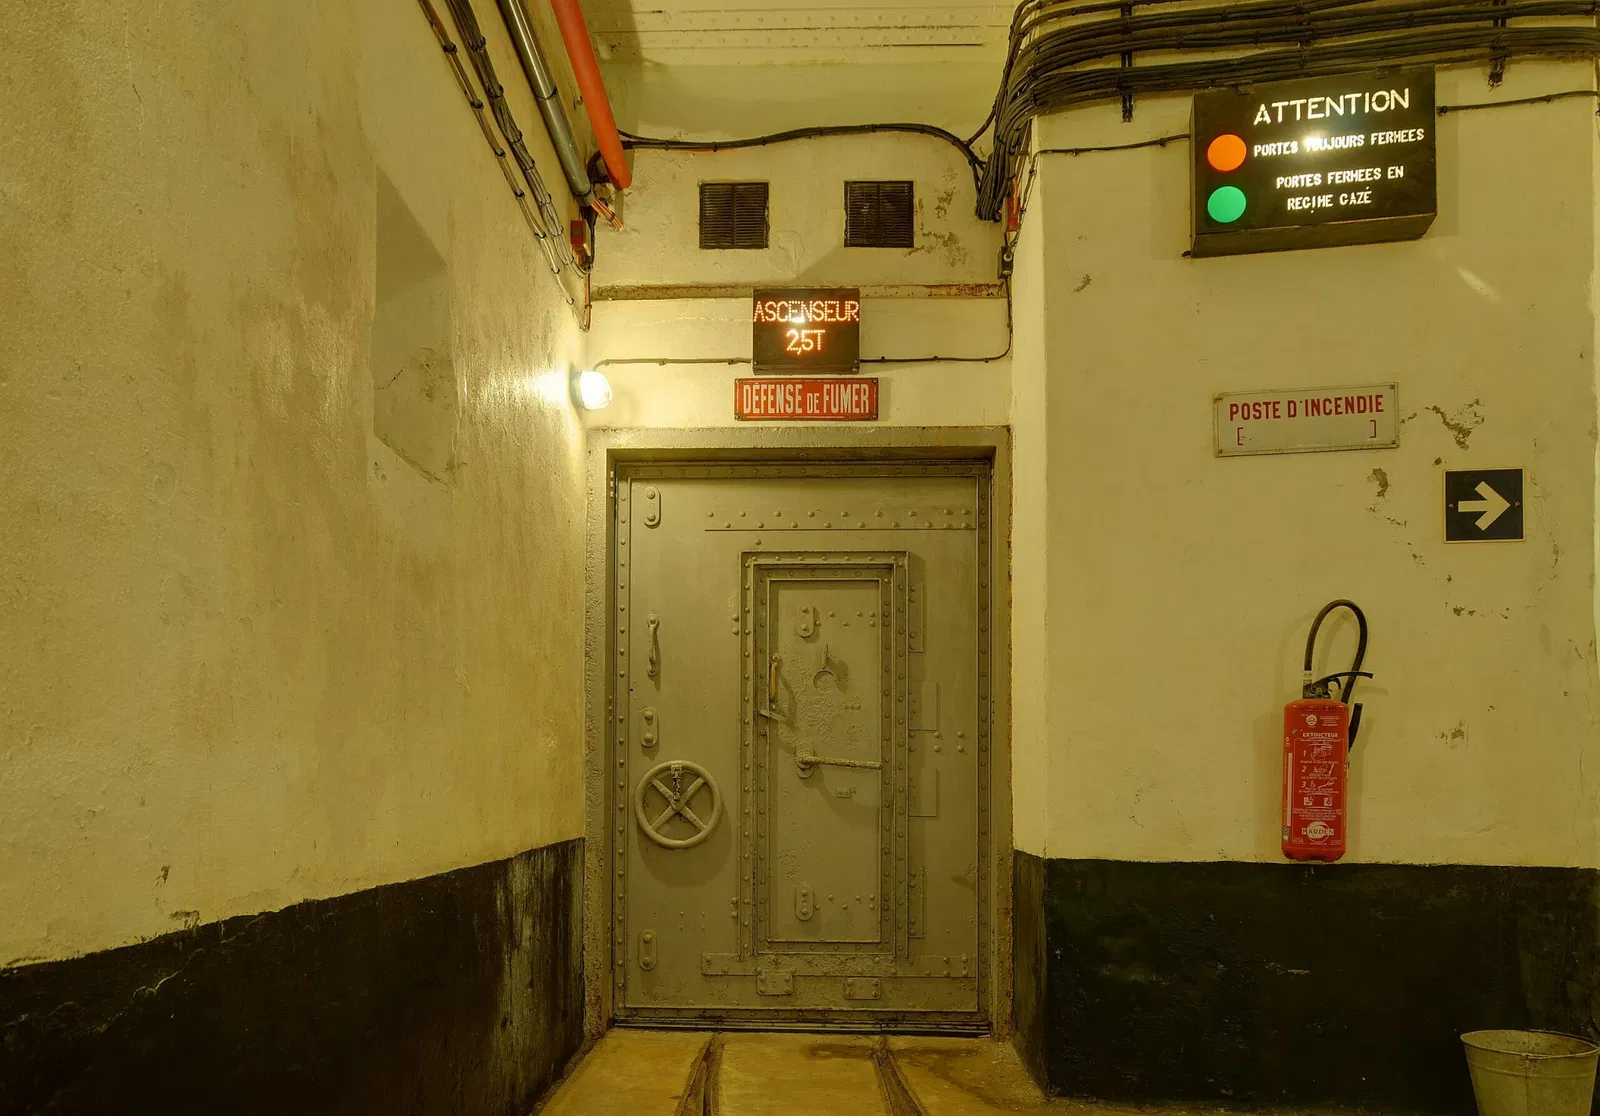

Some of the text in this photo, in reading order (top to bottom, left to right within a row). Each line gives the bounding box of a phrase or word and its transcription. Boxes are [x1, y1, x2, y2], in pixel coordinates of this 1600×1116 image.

[1253, 88, 1410, 126] ATTENTION
[1253, 141, 1298, 157] PORTES
[1304, 134, 1365, 153] TOUJOURS
[1276, 172, 1322, 189] PORTES
[1387, 165, 1404, 180] EN
[753, 300, 860, 323] ASCENSEUR
[785, 329, 826, 355] 2,5T
[743, 382, 869, 414] DÉFENSE DE FUMER
[1229, 394, 1384, 422] POSTE D'INCENDIE
[1301, 765, 1307, 773] 2
[1301, 780, 1307, 788] 3
